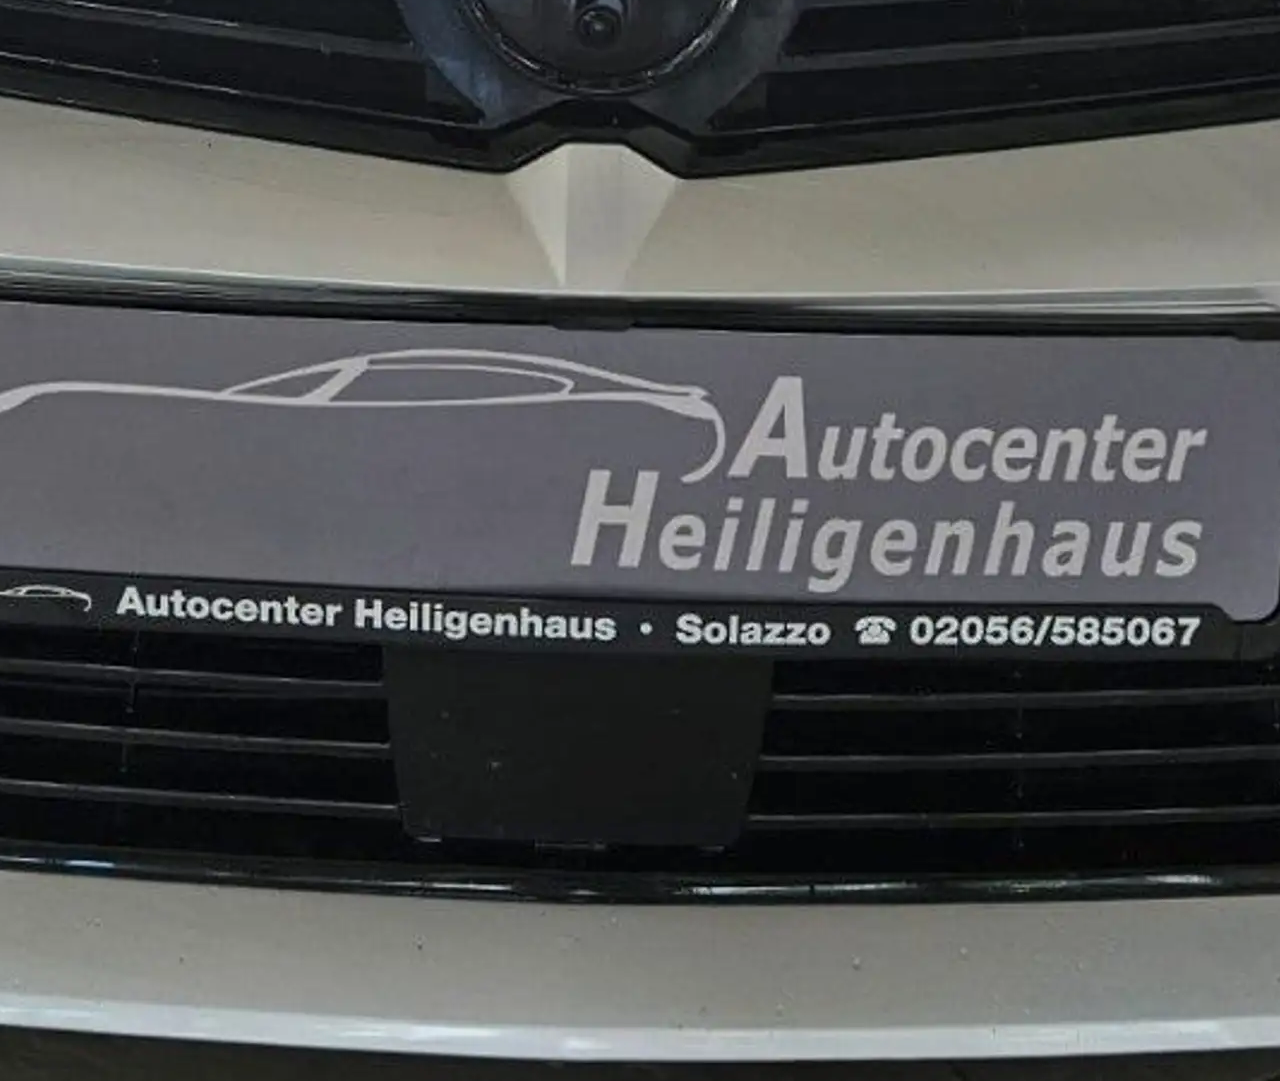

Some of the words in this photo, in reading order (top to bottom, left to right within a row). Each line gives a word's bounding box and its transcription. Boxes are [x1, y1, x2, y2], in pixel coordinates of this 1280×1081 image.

[727, 375, 1208, 483] Autocenter
[570, 469, 1203, 593] Heiligenhaus
[116, 586, 343, 627] Autocenter
[354, 599, 618, 641] Heiligenhaus
[675, 613, 832, 646] Solazzo
[909, 615, 1202, 646] 02056/585067
